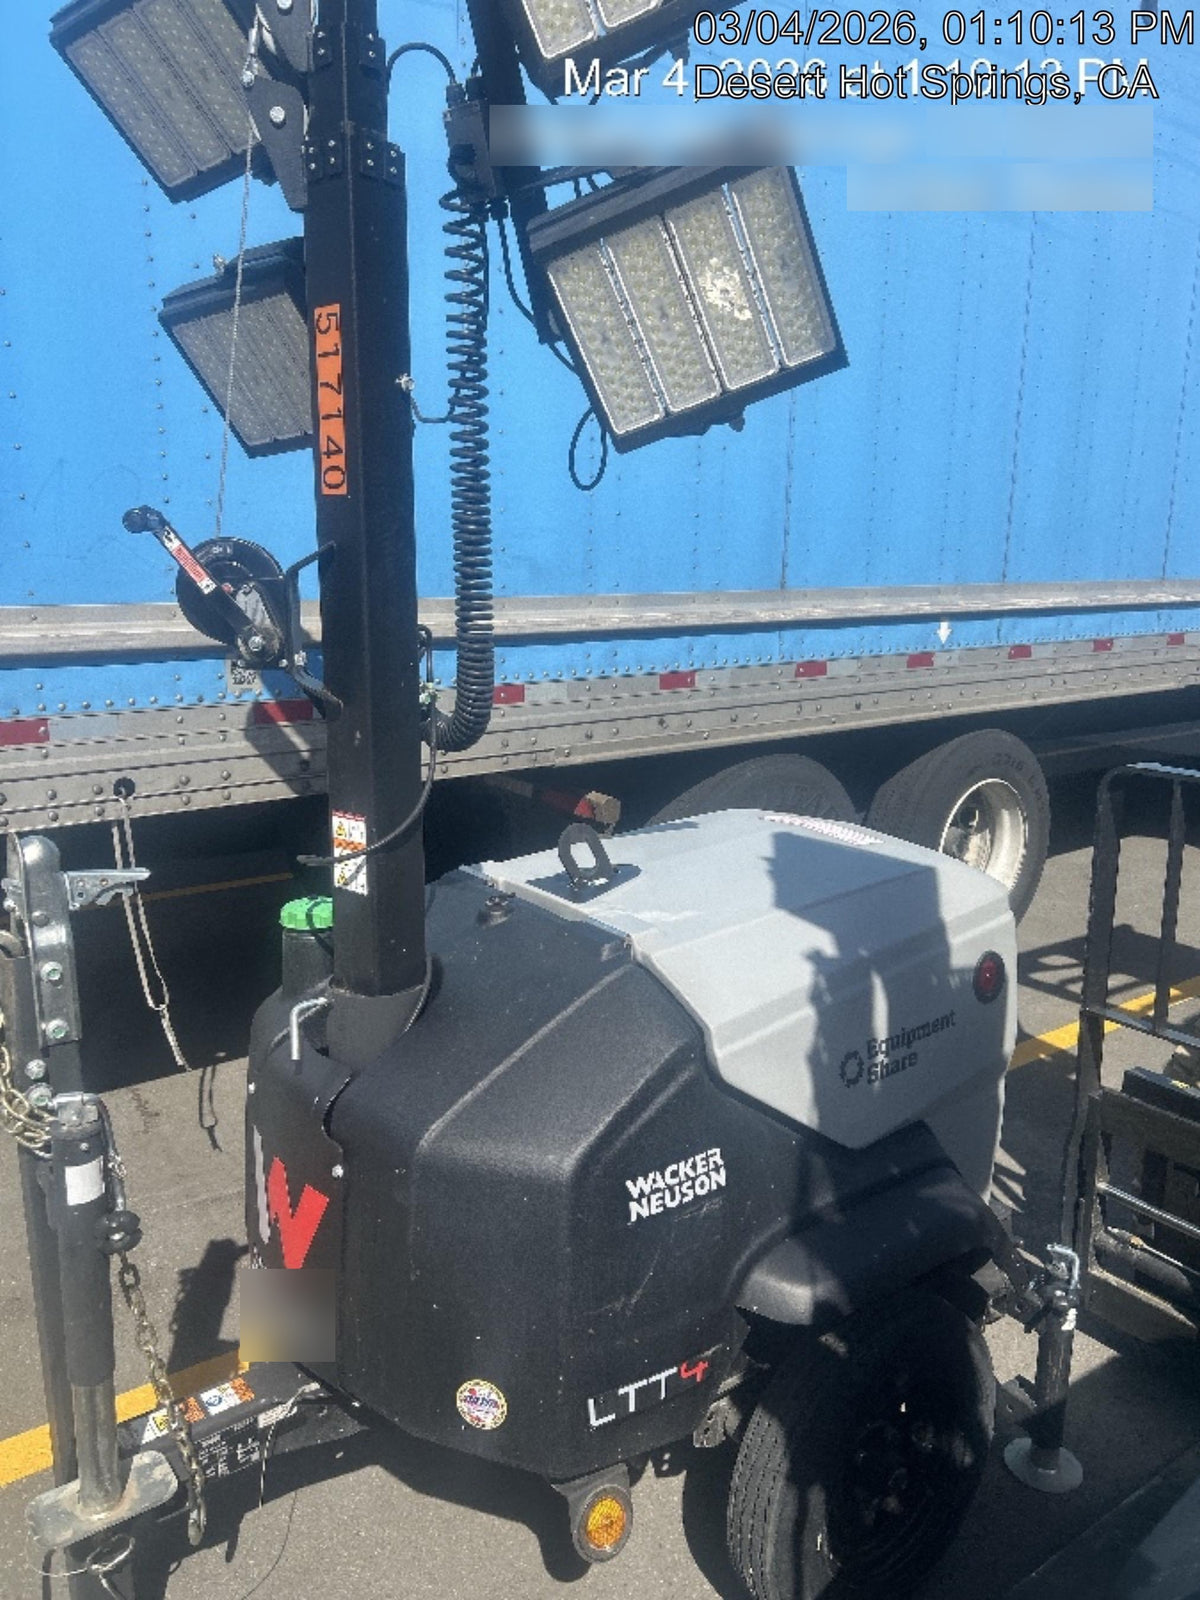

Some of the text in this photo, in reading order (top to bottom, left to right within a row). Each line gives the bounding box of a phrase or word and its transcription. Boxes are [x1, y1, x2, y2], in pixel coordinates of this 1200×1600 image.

[316, 312, 346, 490] 517140
[866, 1009, 956, 1060] Equipment
[867, 1051, 918, 1085] Share
[625, 1147, 725, 1199] WACKER
[628, 1166, 726, 1222] NEUSON
